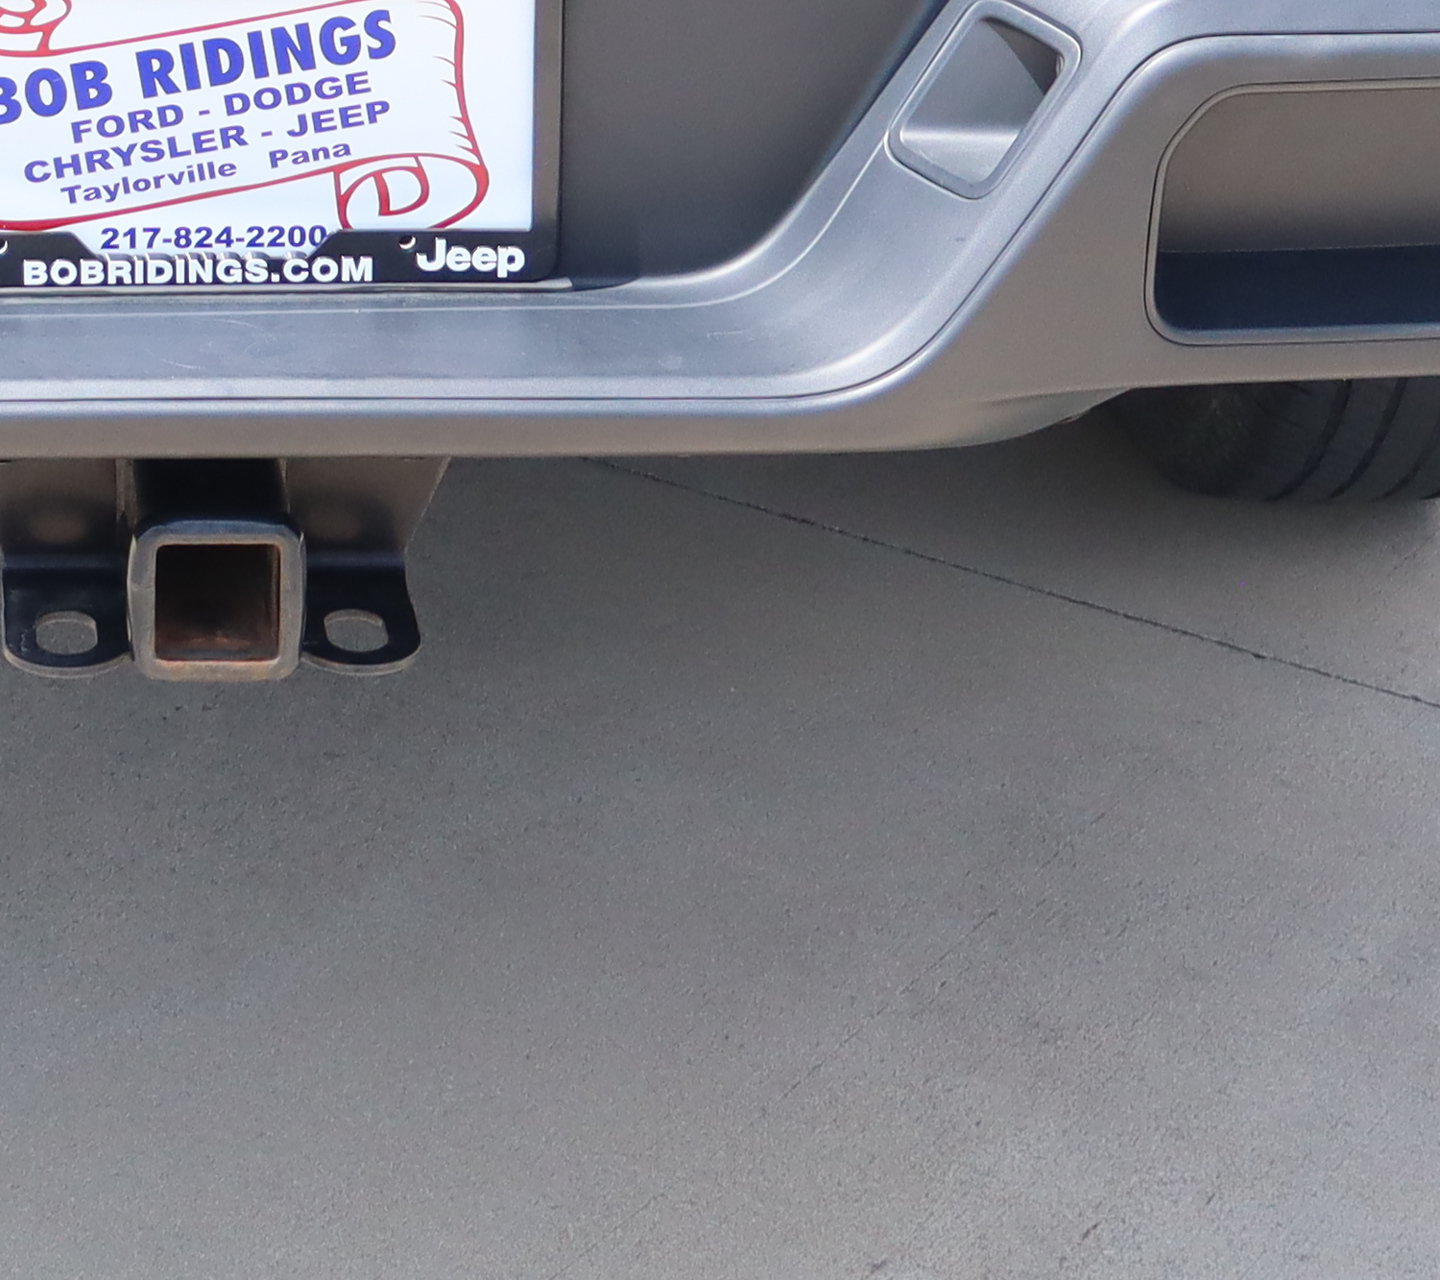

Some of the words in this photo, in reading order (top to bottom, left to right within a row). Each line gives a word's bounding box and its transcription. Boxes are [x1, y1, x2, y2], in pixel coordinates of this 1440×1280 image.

[135, 9, 397, 99] RIDINGS
[70, 103, 184, 144] FORD
[223, 71, 372, 116] DODGE
[23, 124, 249, 184] CHRYSLER
[286, 100, 391, 138] JEEP
[60, 158, 238, 204] Taylorville
[269, 142, 352, 169] Pana
[100, 226, 329, 249] 217-824-2200
[416, 237, 525, 278] Jeep
[23, 256, 373, 286] BOBRIDINGS.COM
